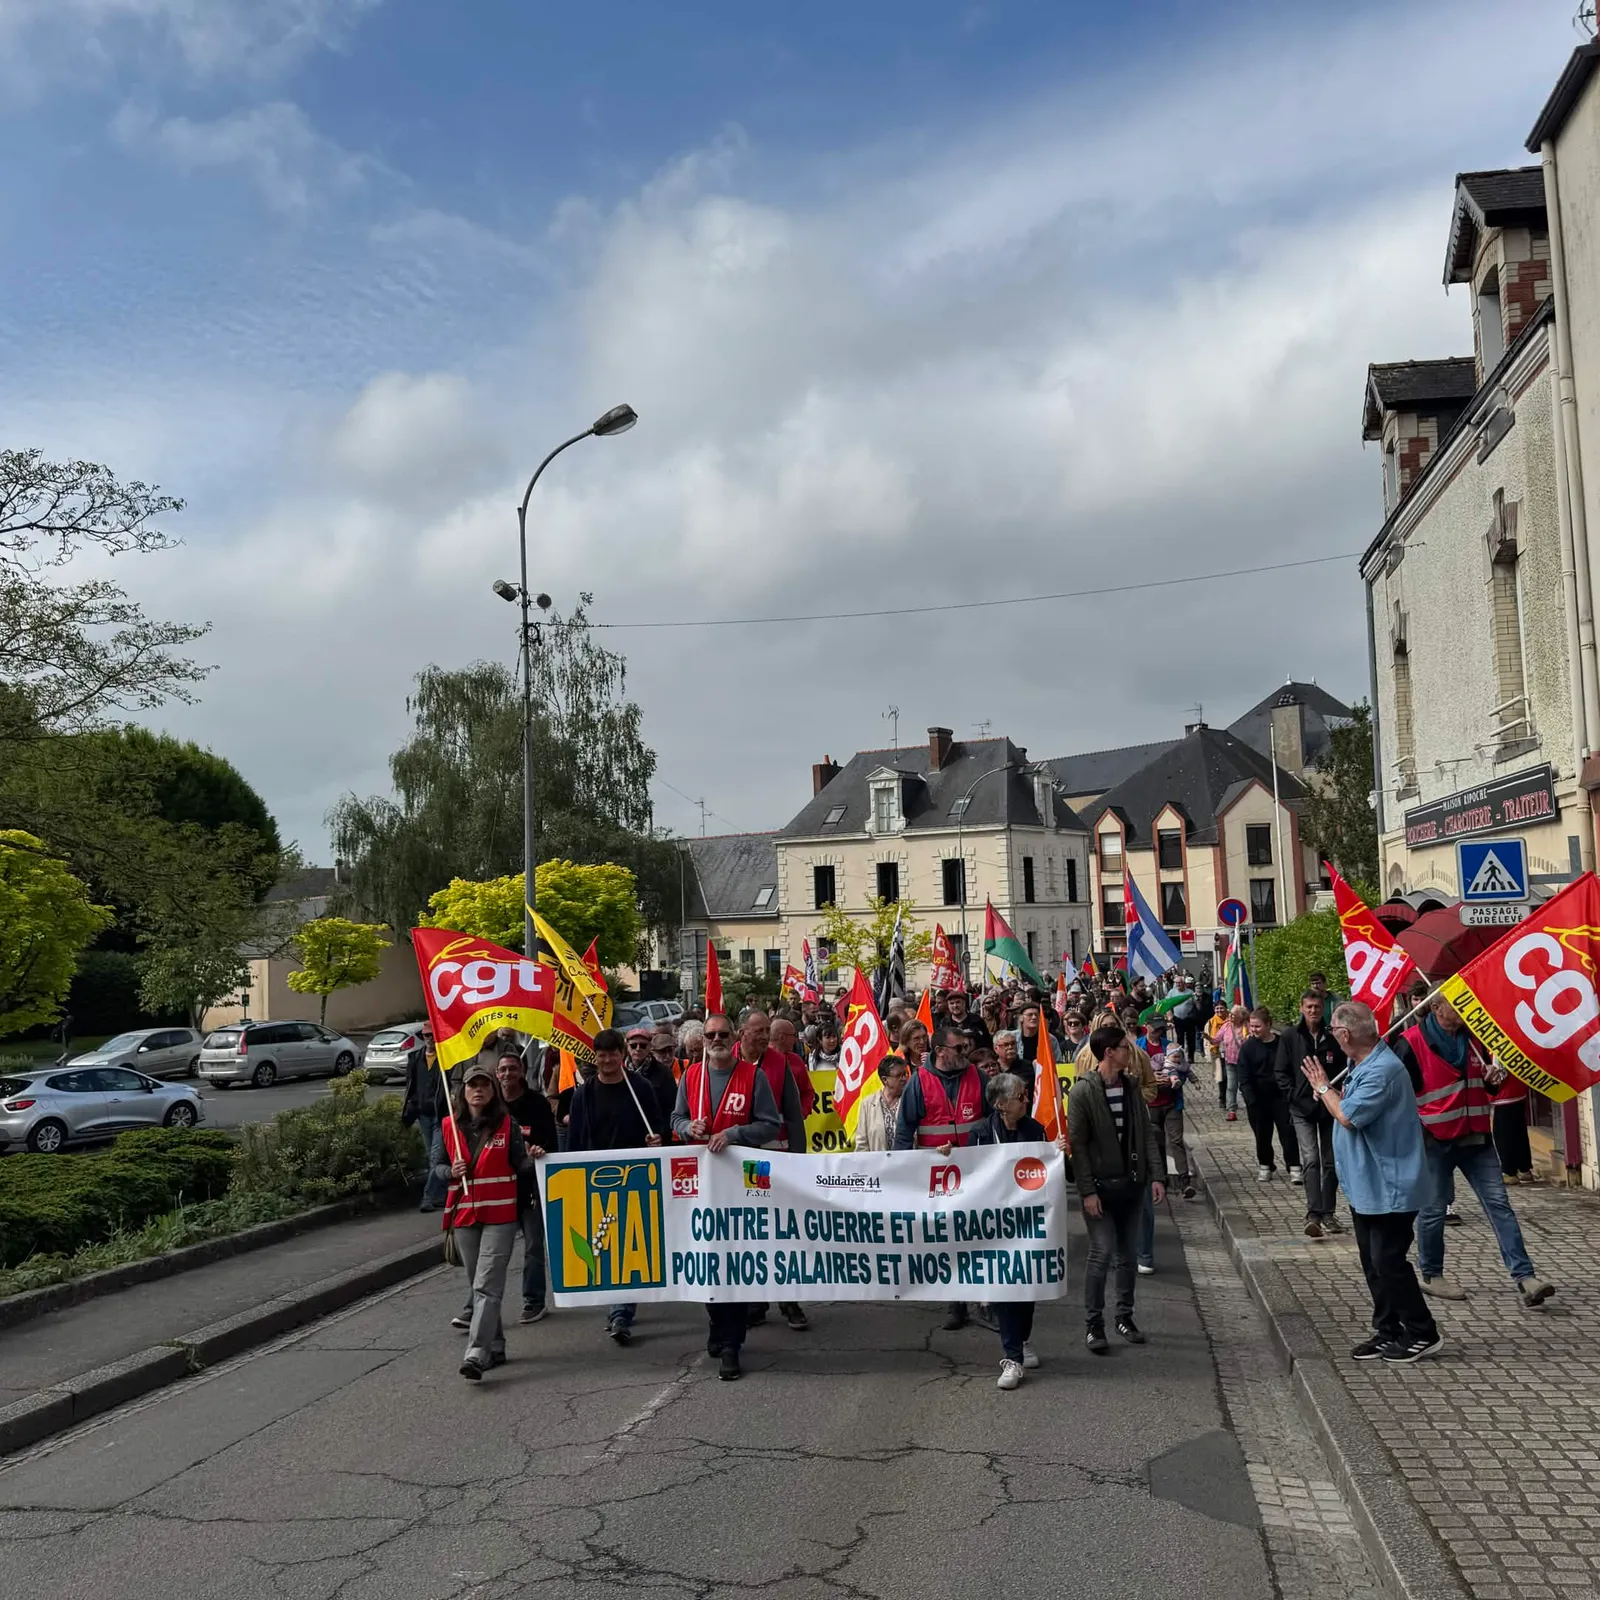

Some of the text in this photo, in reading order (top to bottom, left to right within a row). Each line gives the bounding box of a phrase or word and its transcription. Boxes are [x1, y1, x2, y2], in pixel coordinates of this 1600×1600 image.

[1469, 912, 1523, 925] SURÉLEVÉ
[1472, 906, 1519, 917] PASSAGE
[430, 959, 542, 1011] cgt
[468, 1011, 518, 1040] RETRAITÉS 44
[1452, 990, 1560, 1093] UL CHATEAUBRIANT
[724, 1092, 746, 1112] FO
[672, 1174, 699, 1194] cgt
[816, 1174, 865, 1187] Solidaires
[866, 1176, 881, 1189] 44
[929, 1164, 962, 1197] FO
[691, 1205, 1047, 1243] CONTRE LA GUERRE ET LE RACISME
[672, 1246, 1065, 1286] POUR NOS SALAIRES ET NOS RETRAITES
